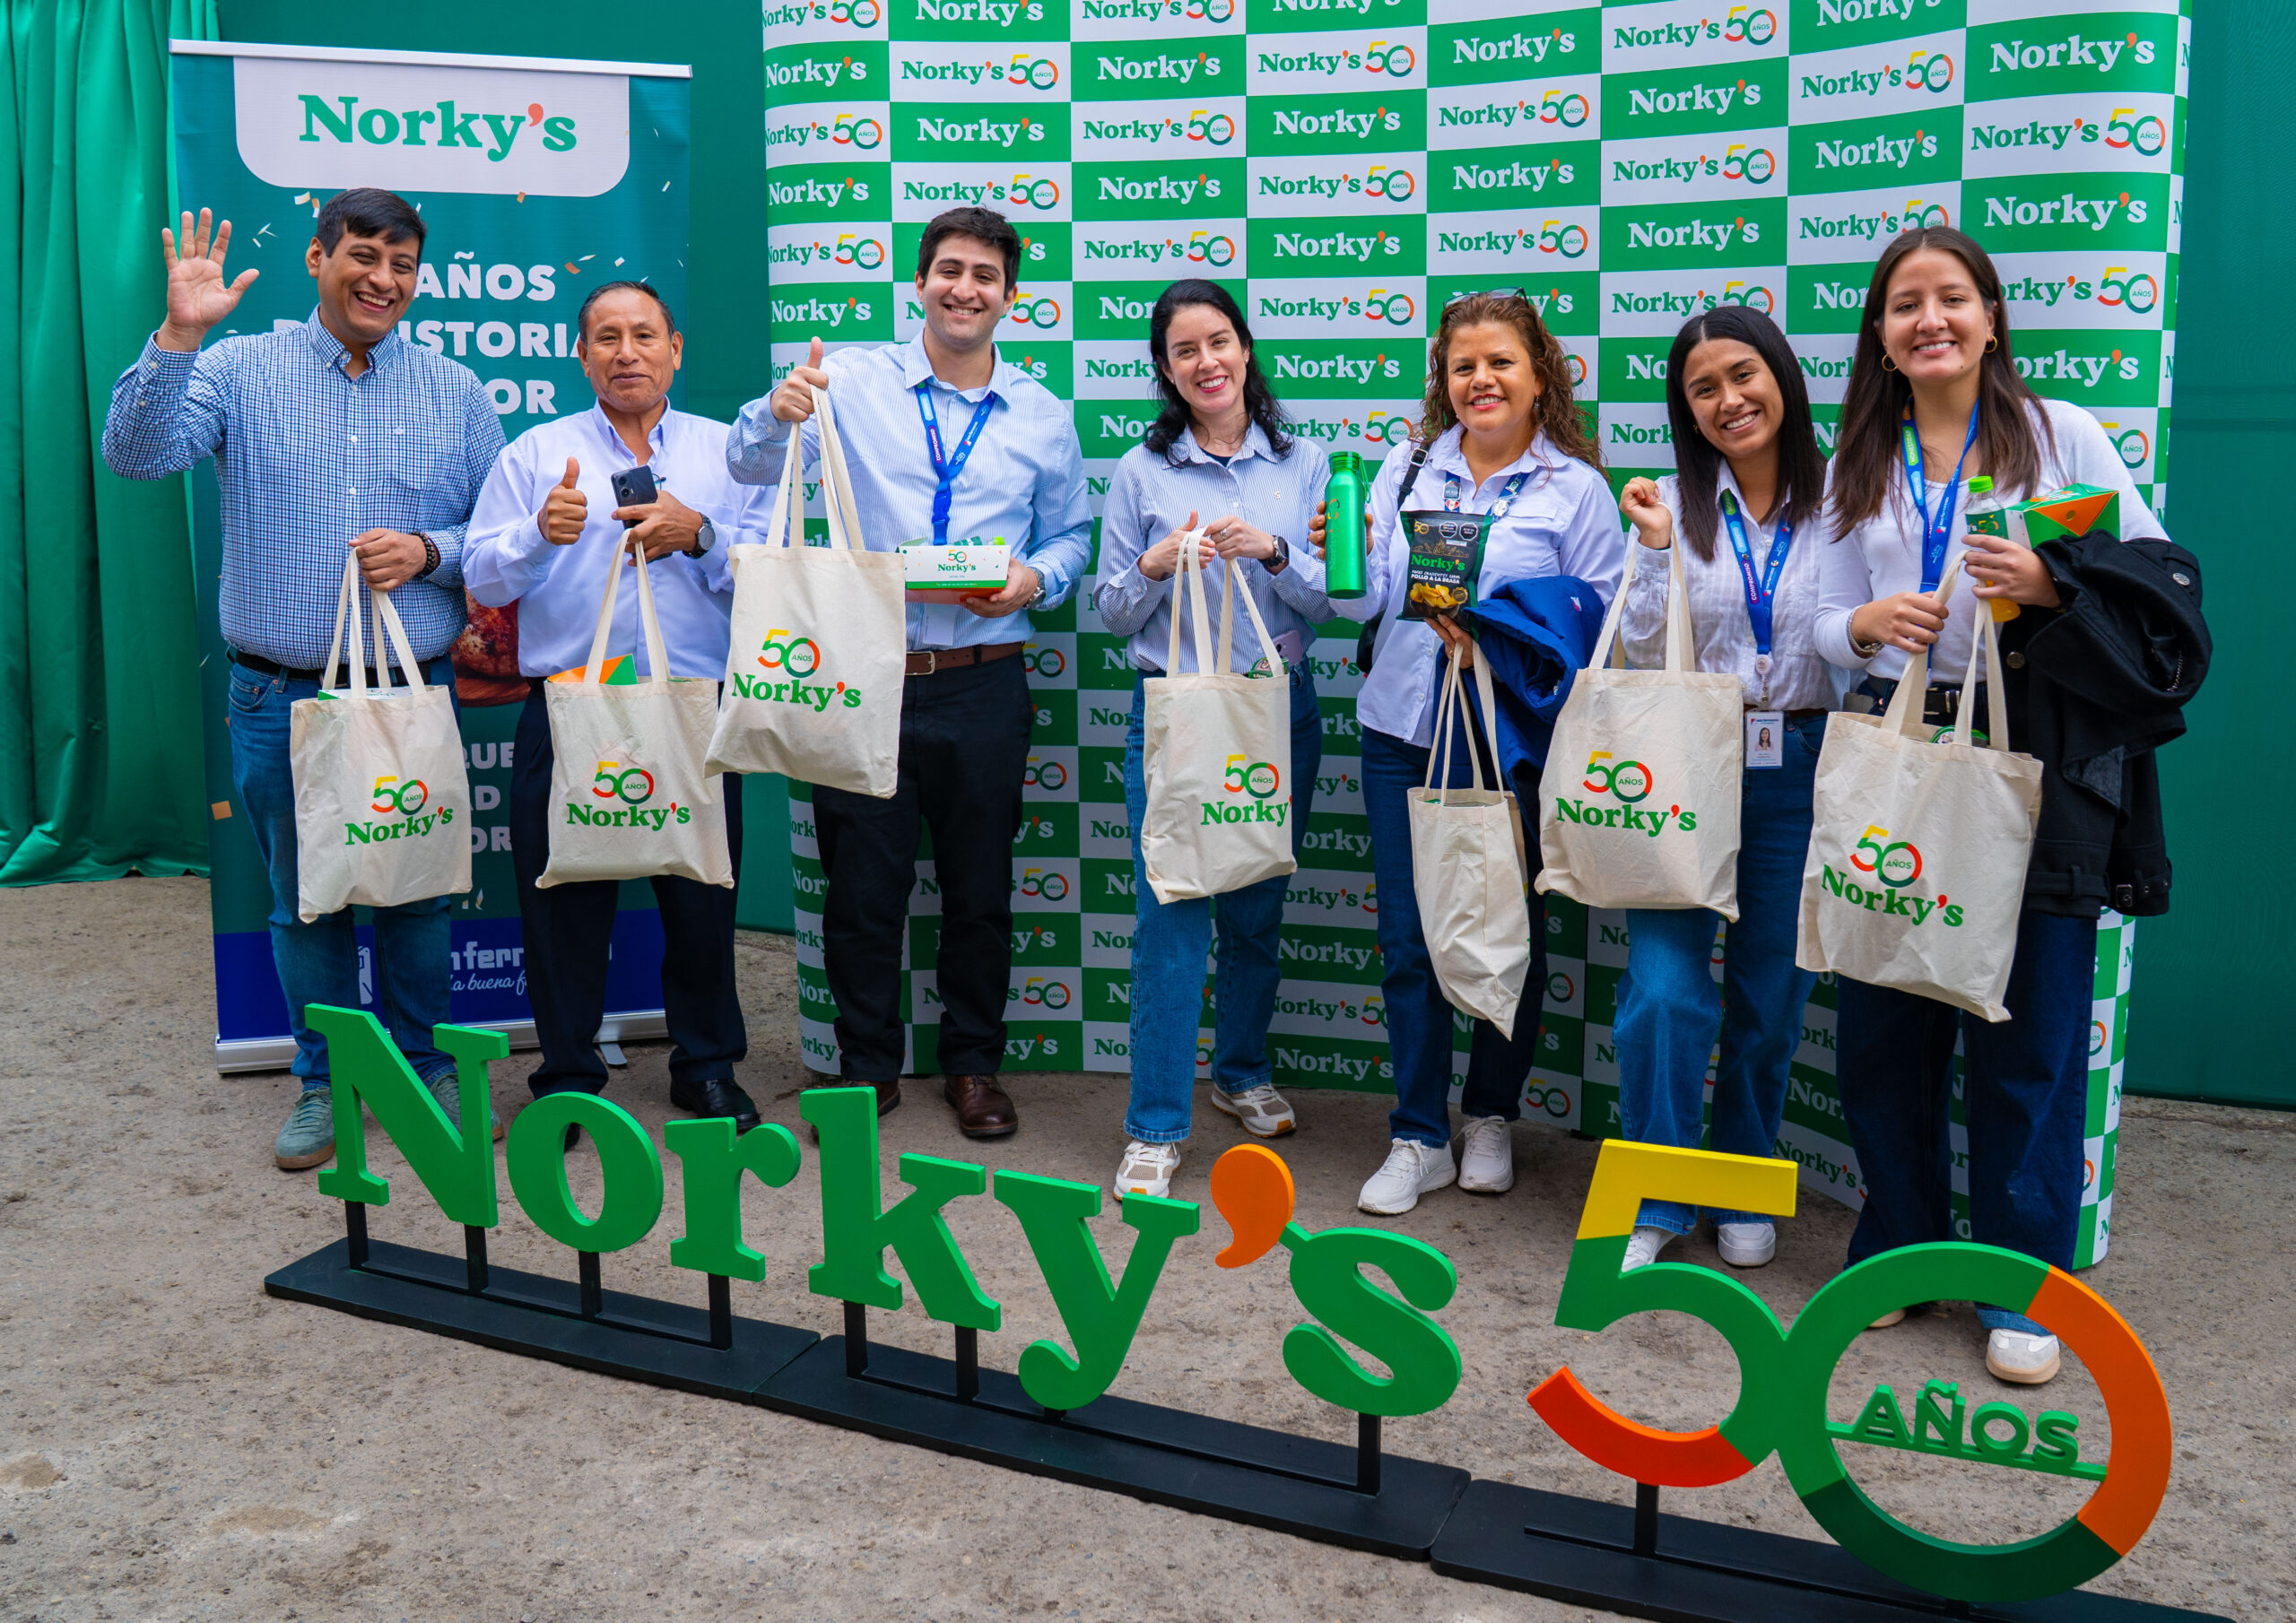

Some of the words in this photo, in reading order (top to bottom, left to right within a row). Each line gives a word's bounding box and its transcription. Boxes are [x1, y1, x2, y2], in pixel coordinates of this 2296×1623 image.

[916, 0, 1043, 27] Norky's
[1083, 0, 1182, 22] Norky's
[1614, 19, 1719, 48] Norky's
[1724, 5, 1778, 46] 50
[1258, 51, 1361, 75] Norky's
[1366, 41, 1414, 77] 50
[1454, 29, 1575, 63] Norky's
[1990, 32, 2154, 72] Norky's
[766, 56, 866, 88] Norky's
[901, 62, 1004, 84] Norky's
[1009, 55, 1057, 91] 50
[1098, 52, 1220, 83] Norky's
[1801, 65, 1901, 98] Norky's
[1905, 50, 1953, 93] 50
[1439, 101, 1535, 127] Norky's
[1541, 90, 1588, 127] 50
[1629, 80, 1761, 115] Norky's
[299, 95, 577, 161] Norky's
[833, 114, 882, 150] 50
[918, 117, 1044, 147] Norky's
[1083, 119, 1183, 143] Norky's
[1187, 110, 1234, 145] 50
[1274, 107, 1400, 138] Norky's
[1971, 119, 2099, 150] Norky's
[2104, 108, 2166, 157] 50
[1613, 155, 1718, 183] Norky's
[1723, 143, 1776, 185] 50
[1815, 129, 1936, 169] Norky's
[770, 178, 868, 207] Norky's
[904, 182, 1005, 204] Norky's
[1010, 175, 1059, 210] 50
[1099, 174, 1221, 204] Norky's
[1259, 175, 1361, 198] Norky's
[1366, 166, 1414, 202] 50
[1453, 159, 1574, 192] Norky's
[1799, 212, 1900, 243] Norky's
[1985, 192, 2146, 230] Norky's
[1084, 239, 1183, 263] Norky's
[1188, 231, 1234, 267] 50
[1274, 230, 1400, 262] Norky's
[1439, 230, 1535, 255] Norky's
[1540, 221, 1587, 258] 50
[1628, 217, 1759, 251] Norky's
[836, 234, 884, 270] 50
[413, 249, 556, 302] AÑOS
[2097, 266, 2158, 314] 50
[772, 298, 871, 326] Norky's
[1259, 297, 1361, 321] Norky's
[1366, 290, 1413, 325] 50
[1612, 291, 1717, 317] Norky's
[397, 319, 581, 359] ISTORI
[1274, 354, 1399, 384] Norky's
[2015, 349, 2139, 387] orky's
[1283, 418, 1361, 443] orky's
[937, 563, 976, 572] Norky's
[948, 549, 967, 563] 50
[1411, 553, 1465, 571] Norky's
[1744, 563, 1757, 601] COMPROMISO
[757, 629, 821, 678] 50
[791, 652, 813, 664] AÑOS
[1310, 656, 1361, 680] ky's
[731, 672, 862, 714] Norky's
[592, 761, 655, 803] 50
[624, 781, 648, 790] AÑOS
[1222, 751, 1283, 799] 50
[1251, 776, 1274, 784] AÑOS
[1313, 774, 1360, 795] ky's
[1582, 751, 1653, 803] 50
[1618, 778, 1644, 786] AÑOS
[371, 776, 428, 816] 50
[404, 793, 423, 803] AÑOS
[344, 806, 454, 846] Norky's
[566, 802, 691, 832] Norky's
[1556, 796, 1698, 838] Norky's
[1302, 828, 1373, 858] orky
[1849, 824, 1923, 888] 50
[1885, 859, 1912, 870] AÑOS
[1022, 868, 1068, 901] 50
[1284, 889, 1359, 910] orky's
[1821, 864, 1964, 928] Norky's
[466, 973, 515, 991] buena
[1024, 977, 1070, 1010] 50
[802, 1035, 837, 1061] orky
[1004, 1033, 1058, 1060] ky's
[1274, 1046, 1395, 1080] Norky's
[1525, 1078, 1570, 1118] 50
[305, 1004, 1464, 1418] Norky's
[1527, 1139, 2172, 1602] 50
[1853, 1379, 2081, 1471] AÑOS
